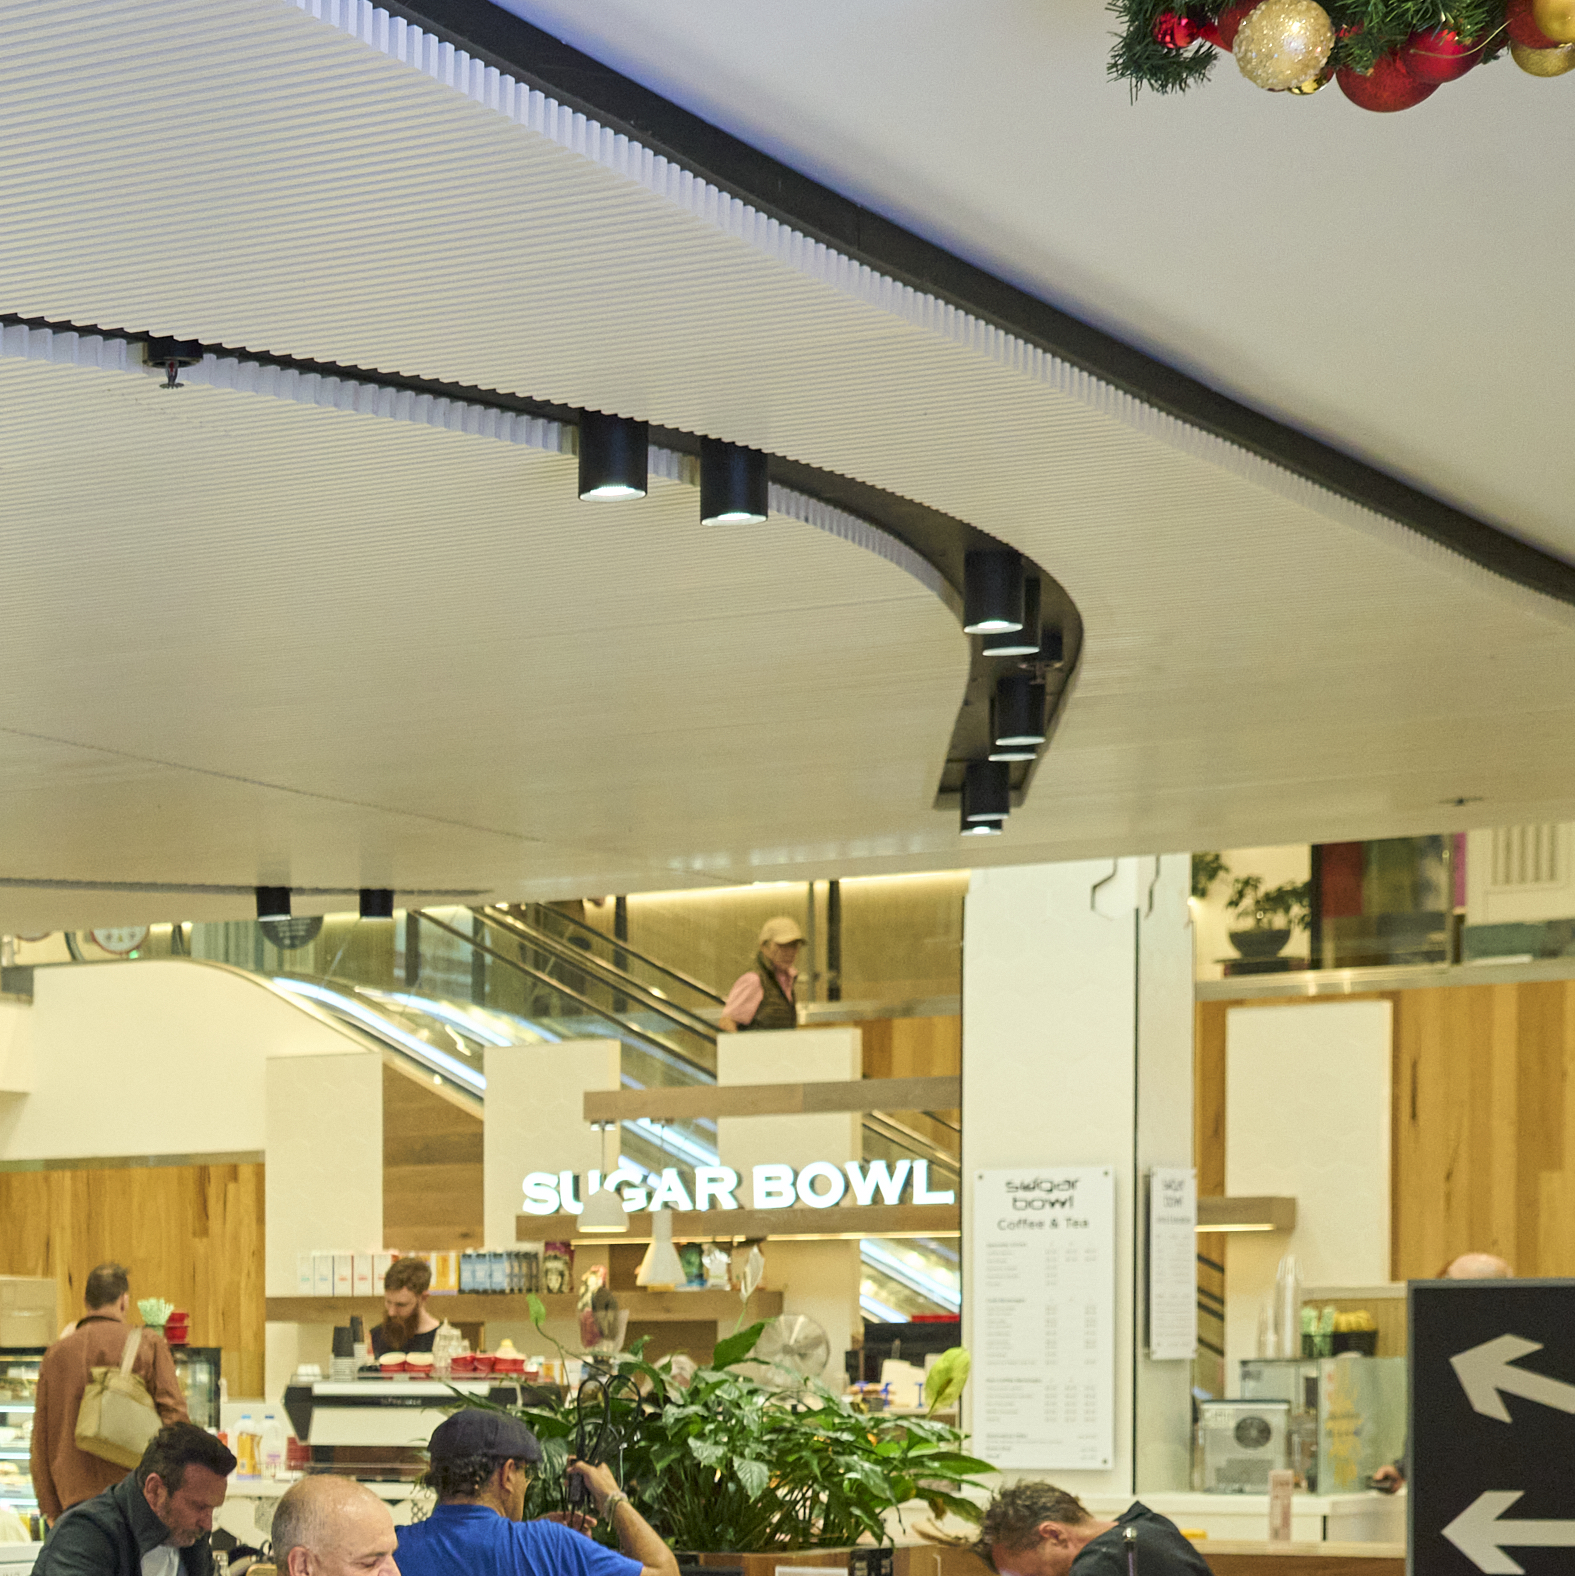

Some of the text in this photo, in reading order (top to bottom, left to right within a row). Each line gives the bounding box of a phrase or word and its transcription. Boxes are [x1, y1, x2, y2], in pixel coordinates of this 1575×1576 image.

[521, 1160, 955, 1214] SUGAR BOWL
[1012, 1196, 1074, 1211] bowl
[997, 1218, 1045, 1231] Coffee
[1065, 1218, 1089, 1229] Tea
